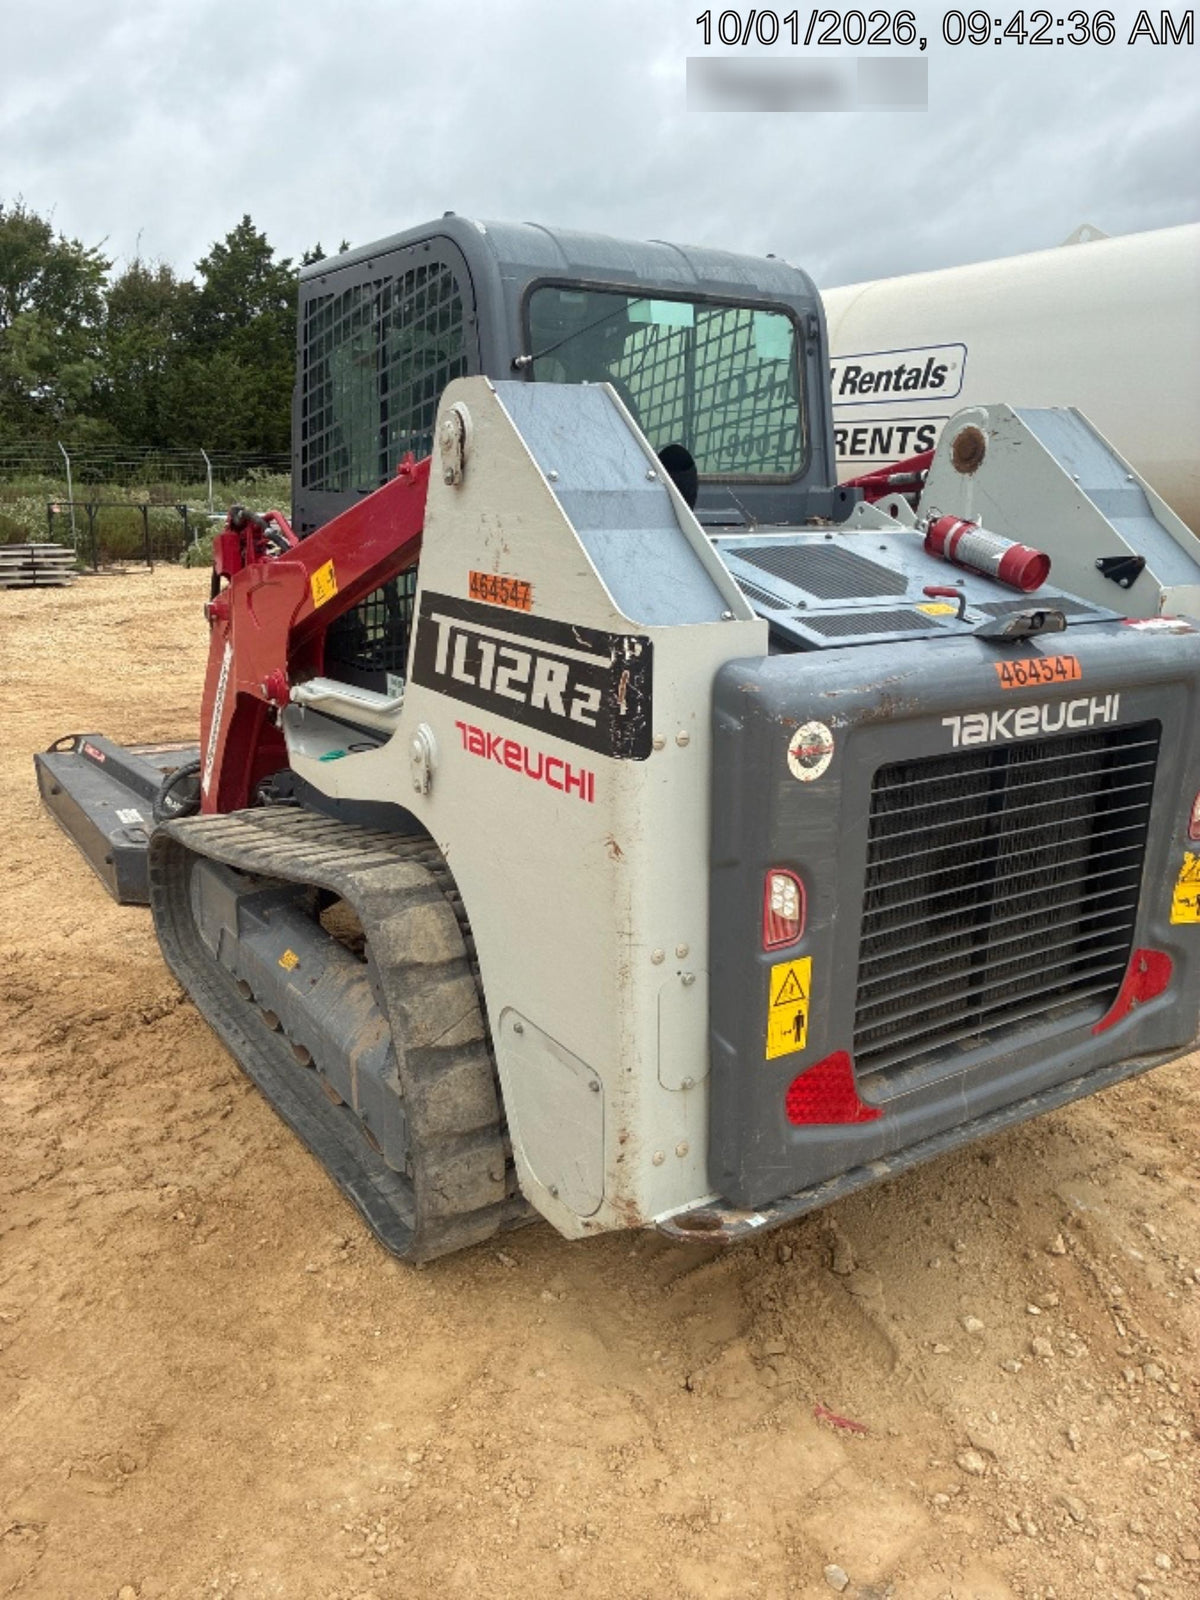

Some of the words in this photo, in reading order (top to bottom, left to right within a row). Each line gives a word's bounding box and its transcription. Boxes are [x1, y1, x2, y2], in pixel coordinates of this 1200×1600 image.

[838, 357, 949, 395] Rentals
[833, 424, 937, 456] RENTS
[469, 571, 531, 609] 464547
[1000, 655, 1077, 687] 464547
